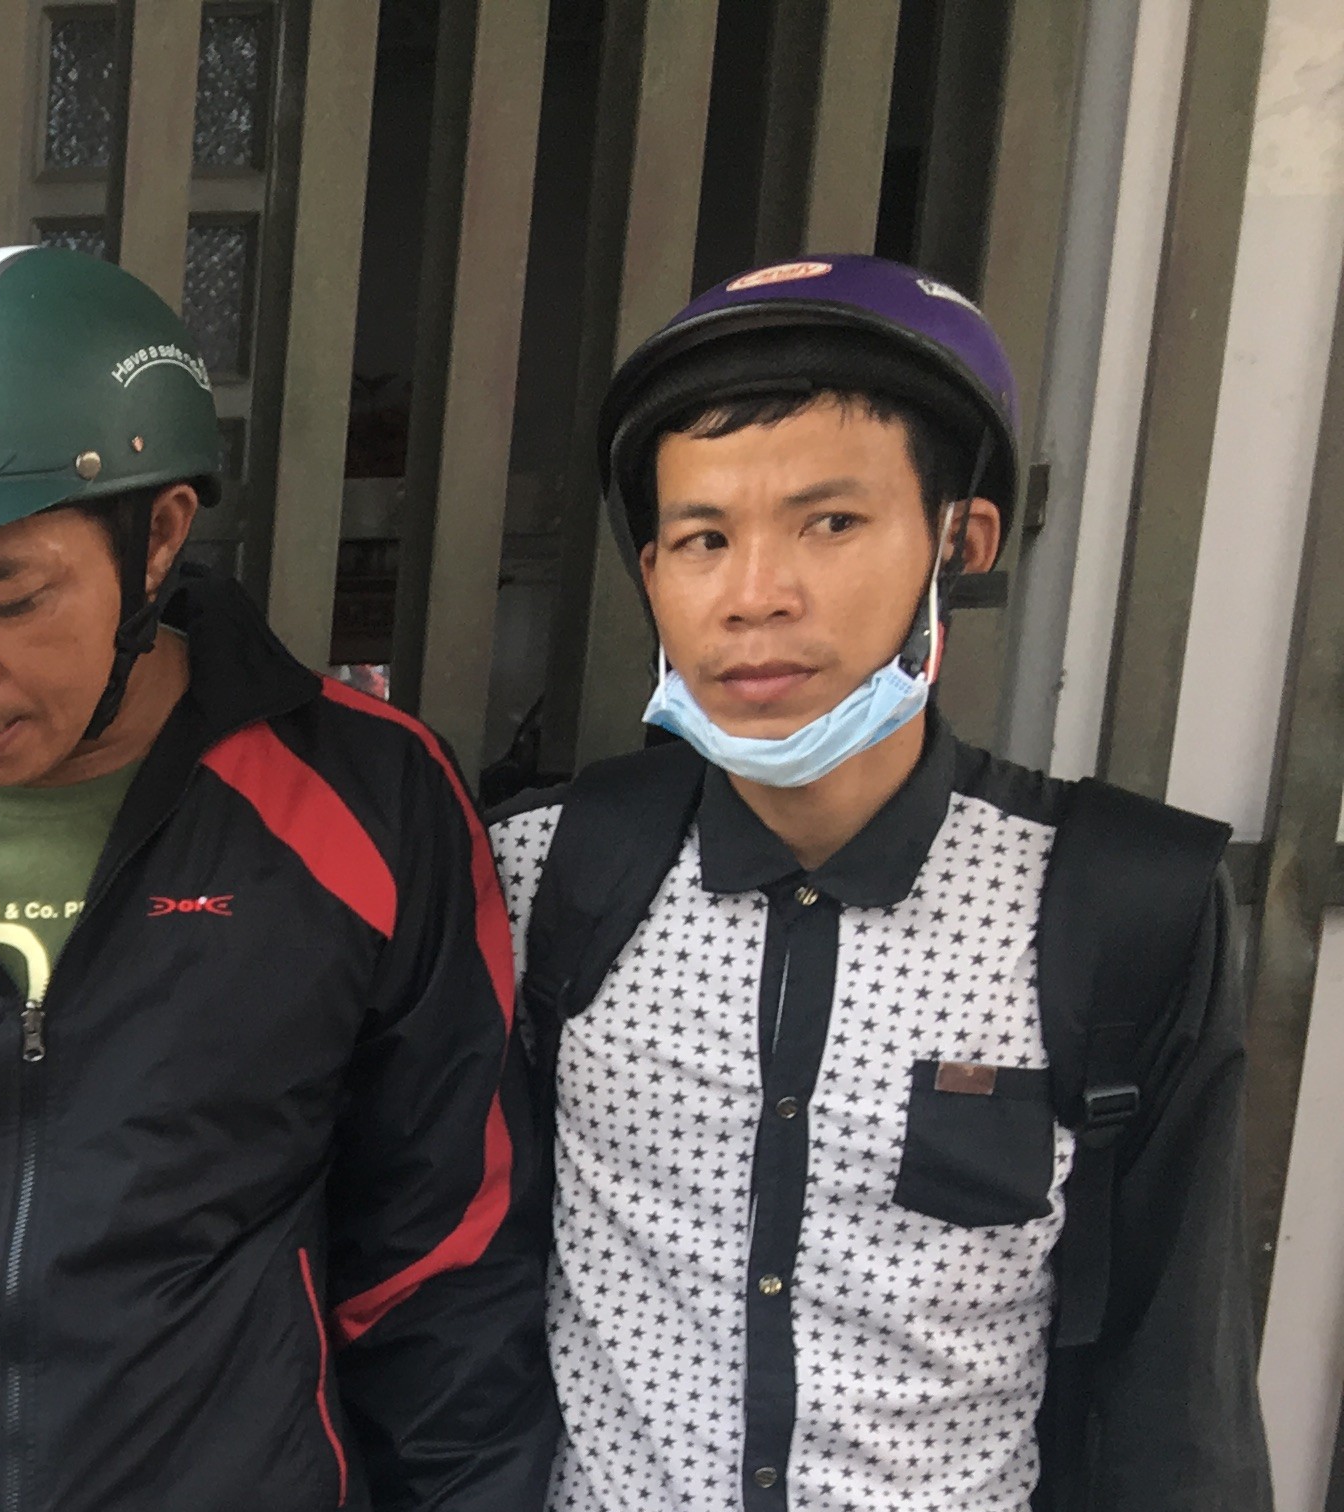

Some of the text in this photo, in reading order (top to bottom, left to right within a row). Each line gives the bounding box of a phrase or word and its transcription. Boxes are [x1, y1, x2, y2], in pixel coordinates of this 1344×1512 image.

[111, 349, 148, 383] Have
[4, 902, 21, 920] &
[24, 901, 59, 919] Co.
